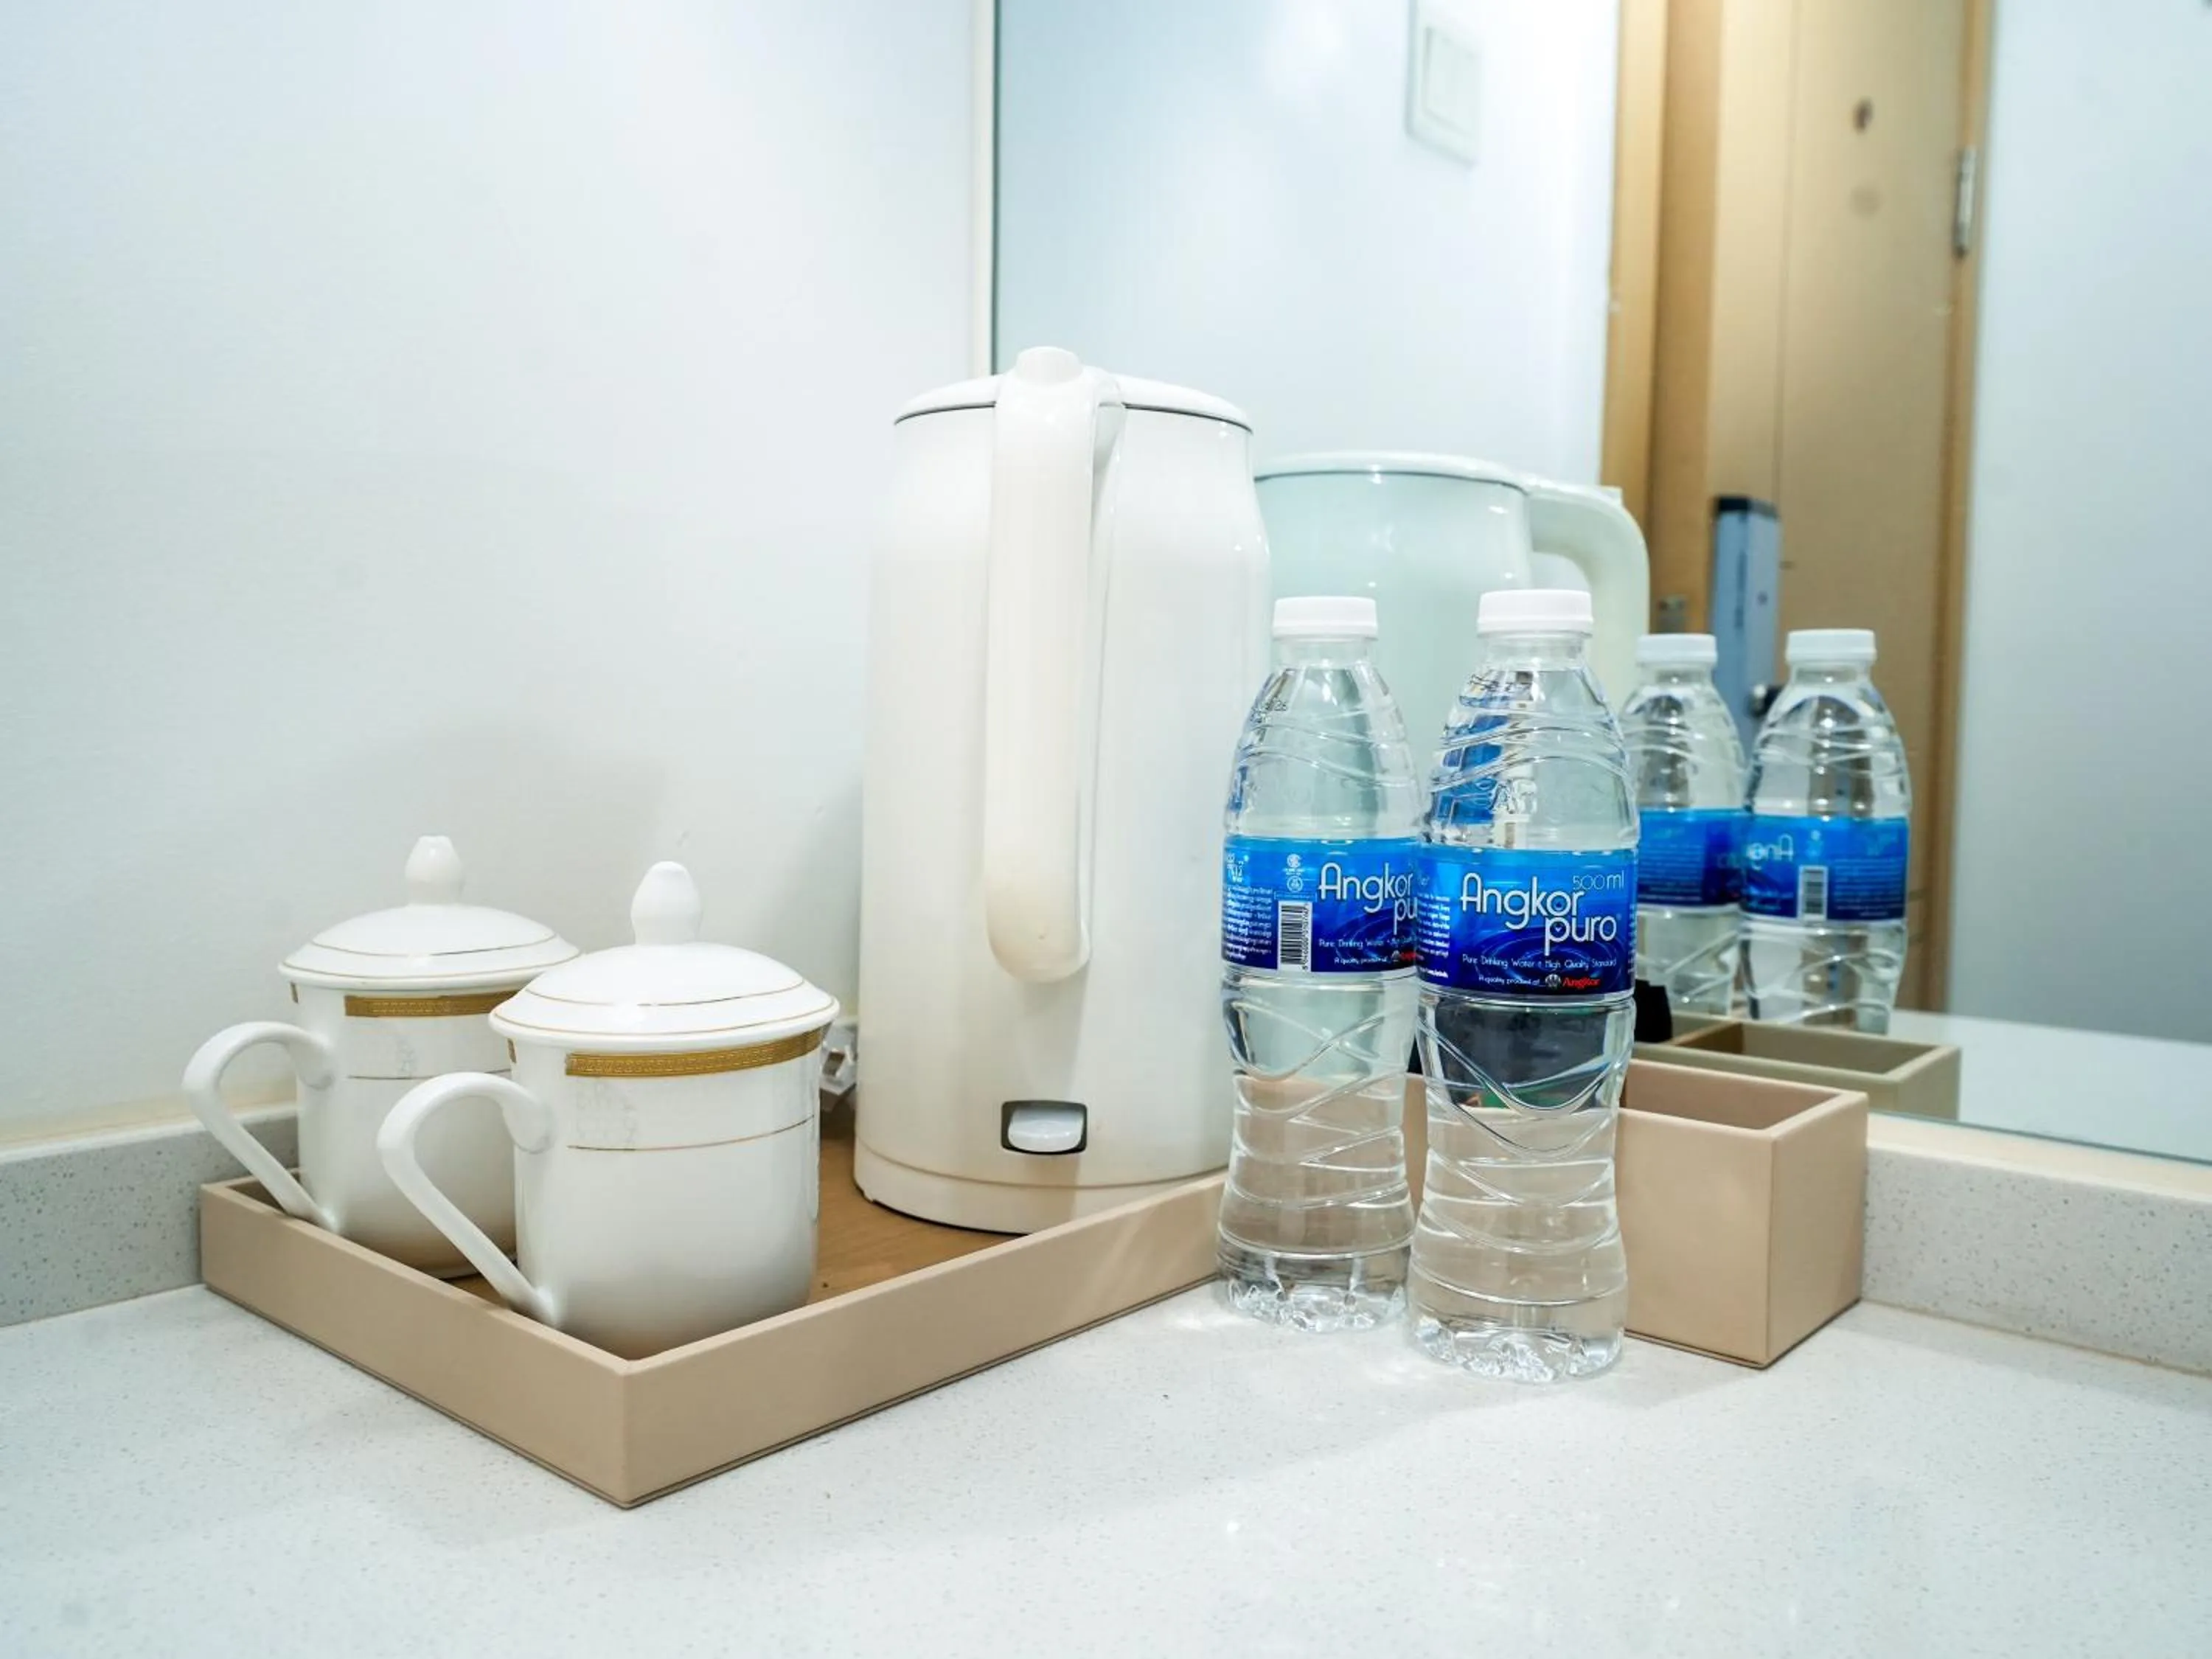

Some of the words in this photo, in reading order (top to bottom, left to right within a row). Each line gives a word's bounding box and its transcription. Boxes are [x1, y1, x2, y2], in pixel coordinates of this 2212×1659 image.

[1318, 862, 1413, 914] Angkor
[1572, 870, 1625, 891] 500ml
[1394, 897, 1418, 936] pu
[1460, 872, 1585, 930] Angkor
[1544, 915, 1617, 956] puro
[1462, 953, 1478, 964] Pure
[1481, 955, 1509, 970] Drinking
[1512, 958, 1535, 968] Water
